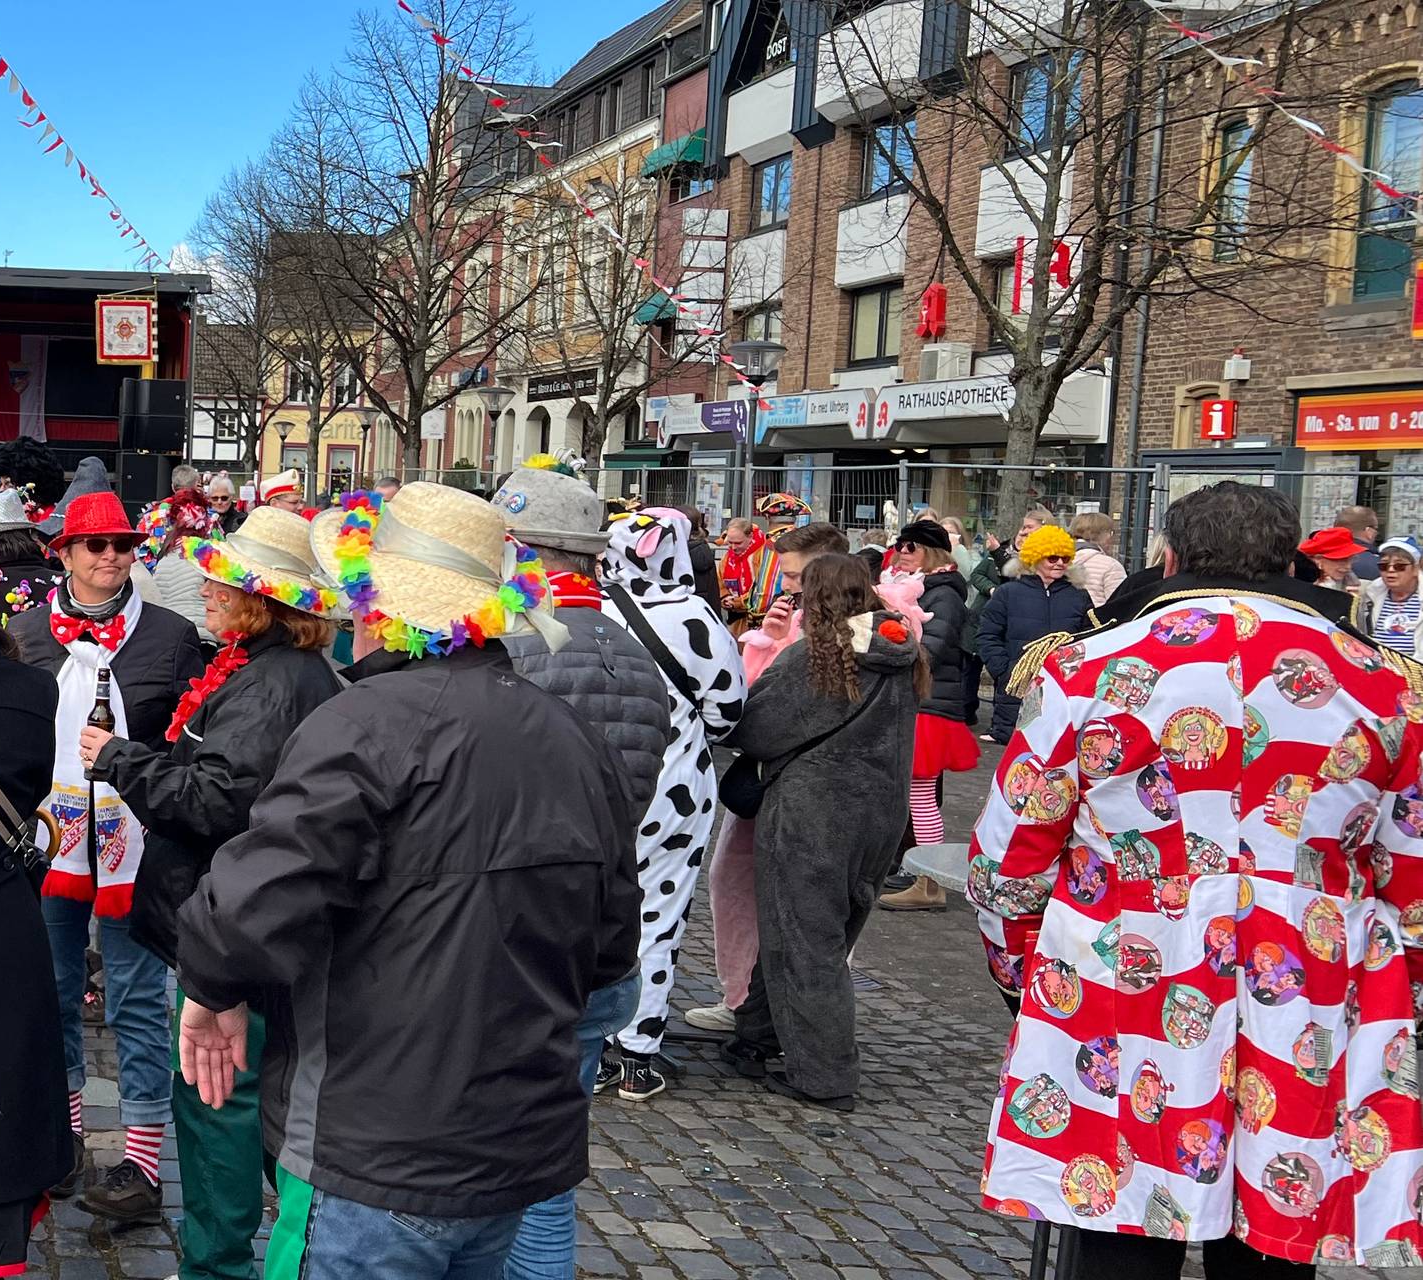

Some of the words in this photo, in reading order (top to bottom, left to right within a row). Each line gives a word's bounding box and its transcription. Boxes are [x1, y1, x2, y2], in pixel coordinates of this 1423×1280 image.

[898, 385, 1008, 409] RATHAUSAPOTHEKE
[1208, 404, 1225, 436] i
[1304, 415, 1326, 432] Mo.
[1336, 413, 1355, 431] Sa.
[1358, 415, 1380, 431] von
[1389, 411, 1398, 429] 8
